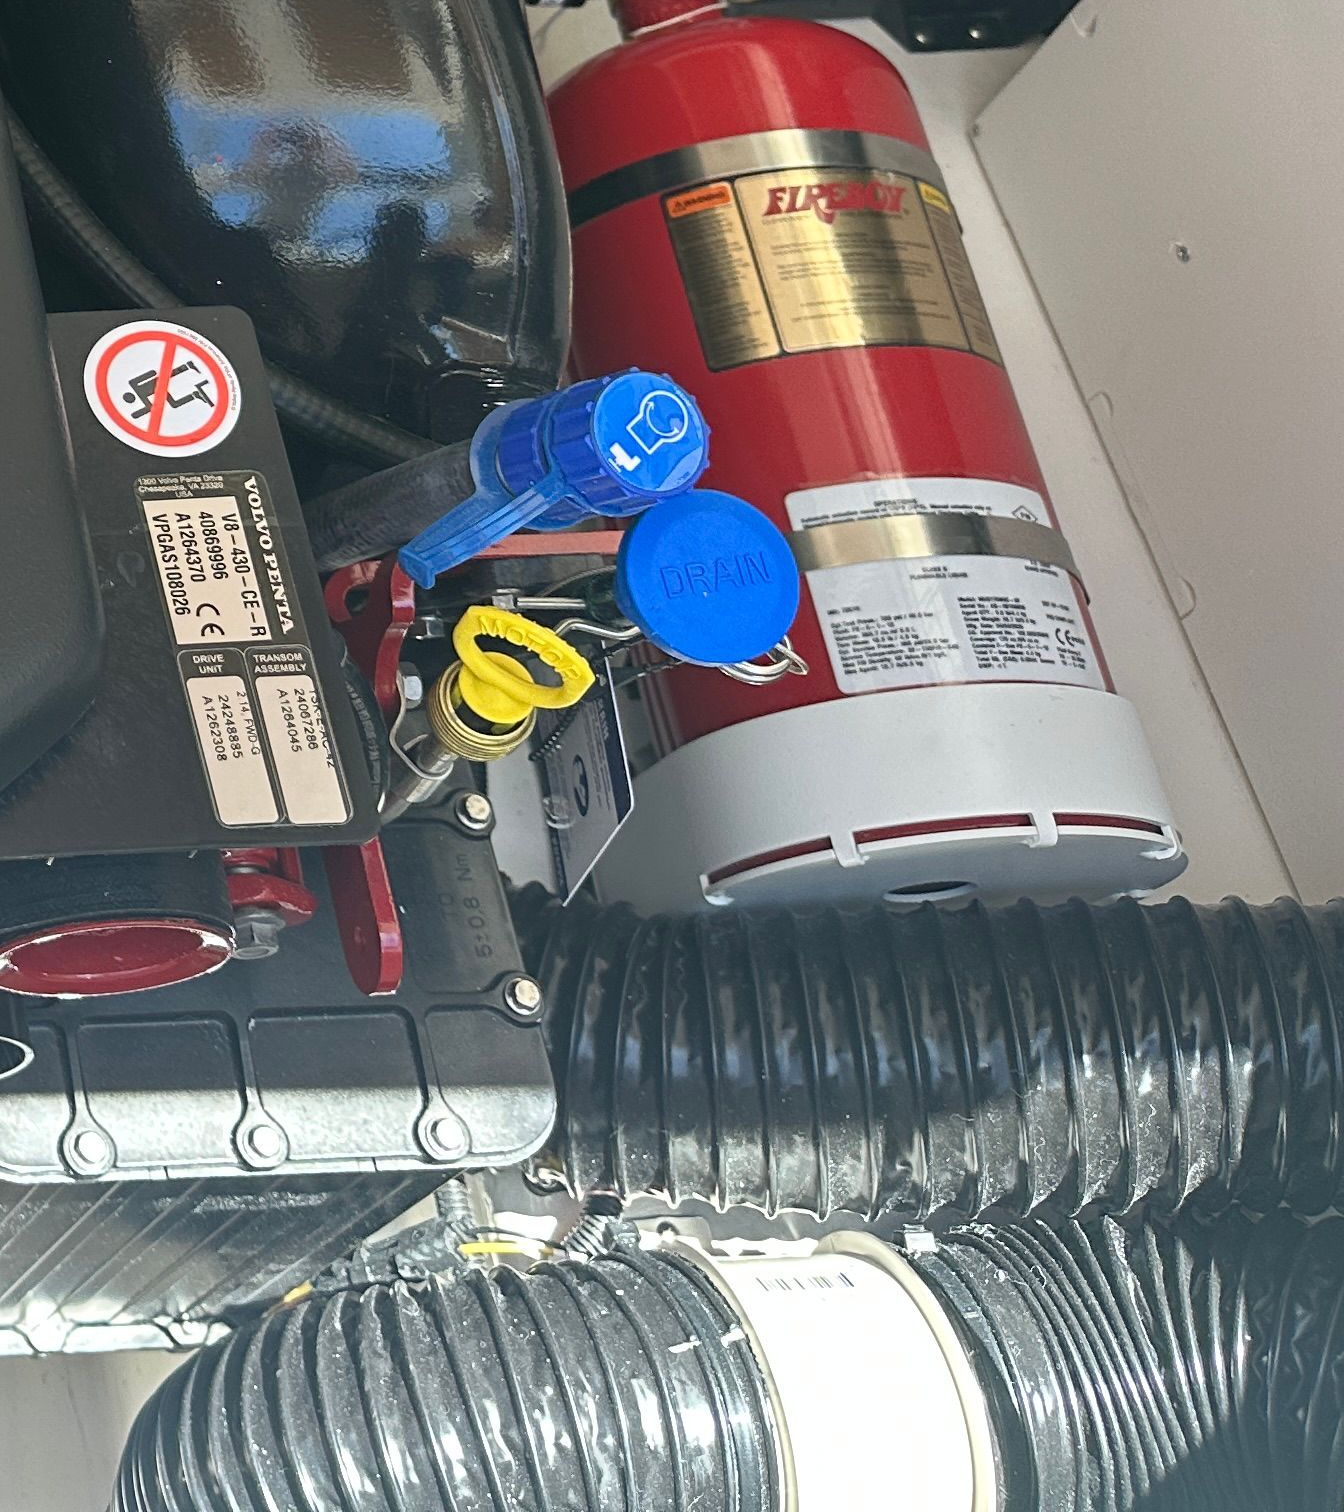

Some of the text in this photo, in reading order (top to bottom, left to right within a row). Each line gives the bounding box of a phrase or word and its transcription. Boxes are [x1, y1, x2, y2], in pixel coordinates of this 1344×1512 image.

[152, 513, 190, 616] VPGAS108026
[174, 512, 206, 582] A1264370
[197, 511, 228, 579] 40869996
[243, 475, 293, 634] VOLVO PENTA
[661, 552, 774, 602] DRAIN
[194, 654, 224, 663] DRIVE
[199, 665, 222, 673] UNIT
[253, 652, 302, 662] TRANSOM
[254, 663, 306, 673] ASSEMBLY
[454, 853, 472, 881] Nm
